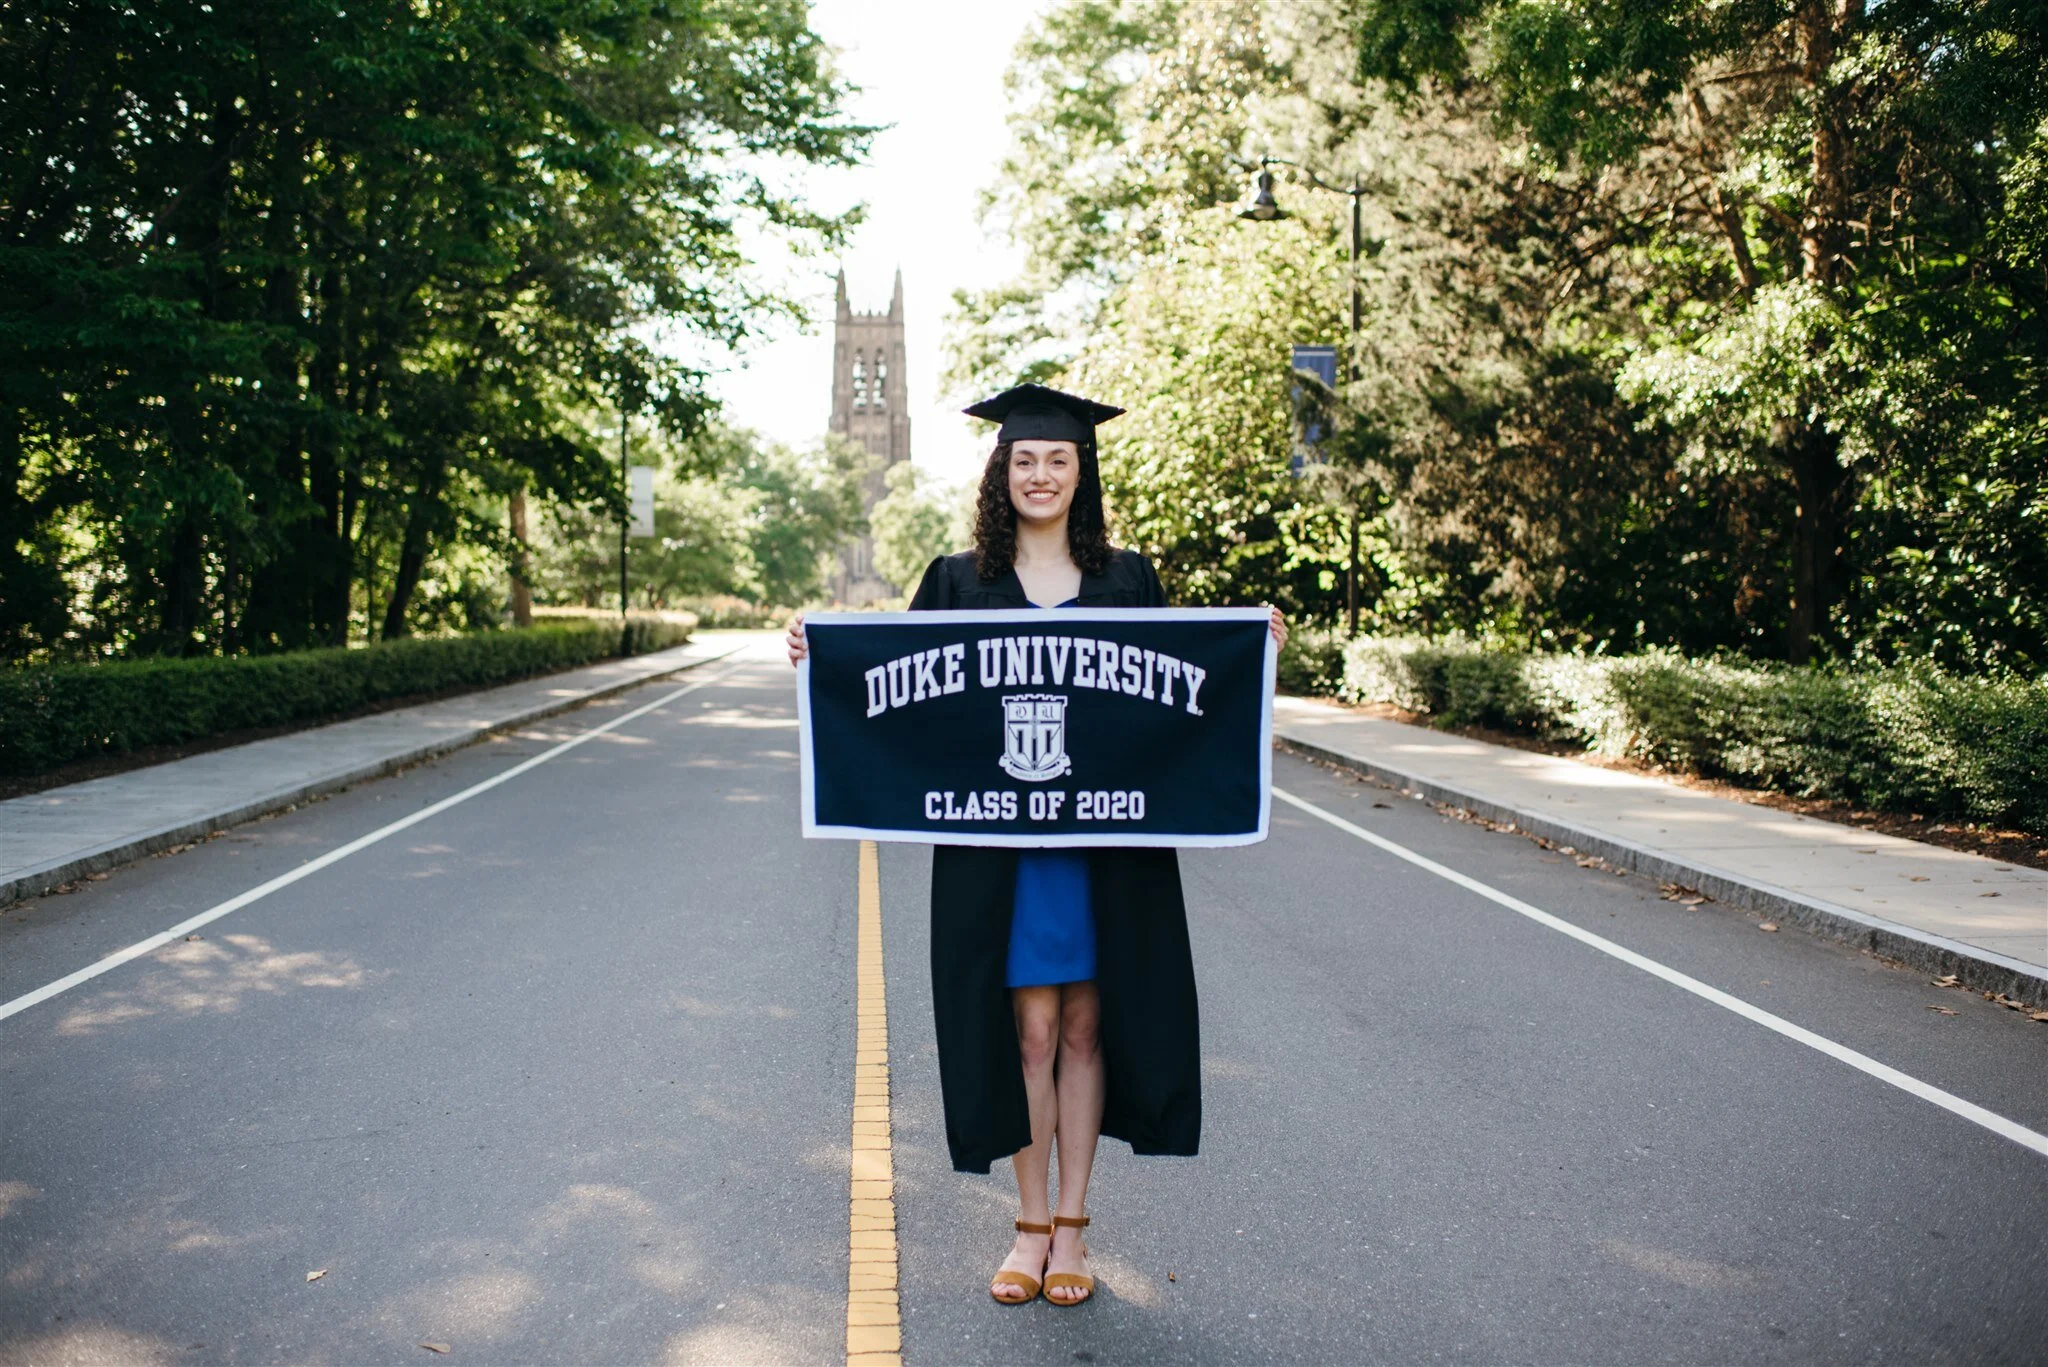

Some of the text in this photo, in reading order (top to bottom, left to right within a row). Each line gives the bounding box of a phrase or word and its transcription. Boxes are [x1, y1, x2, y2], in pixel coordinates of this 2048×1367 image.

[865, 635, 1206, 718] DUKE UNIVERSITY
[925, 790, 1145, 821] CLASS OF 2020
